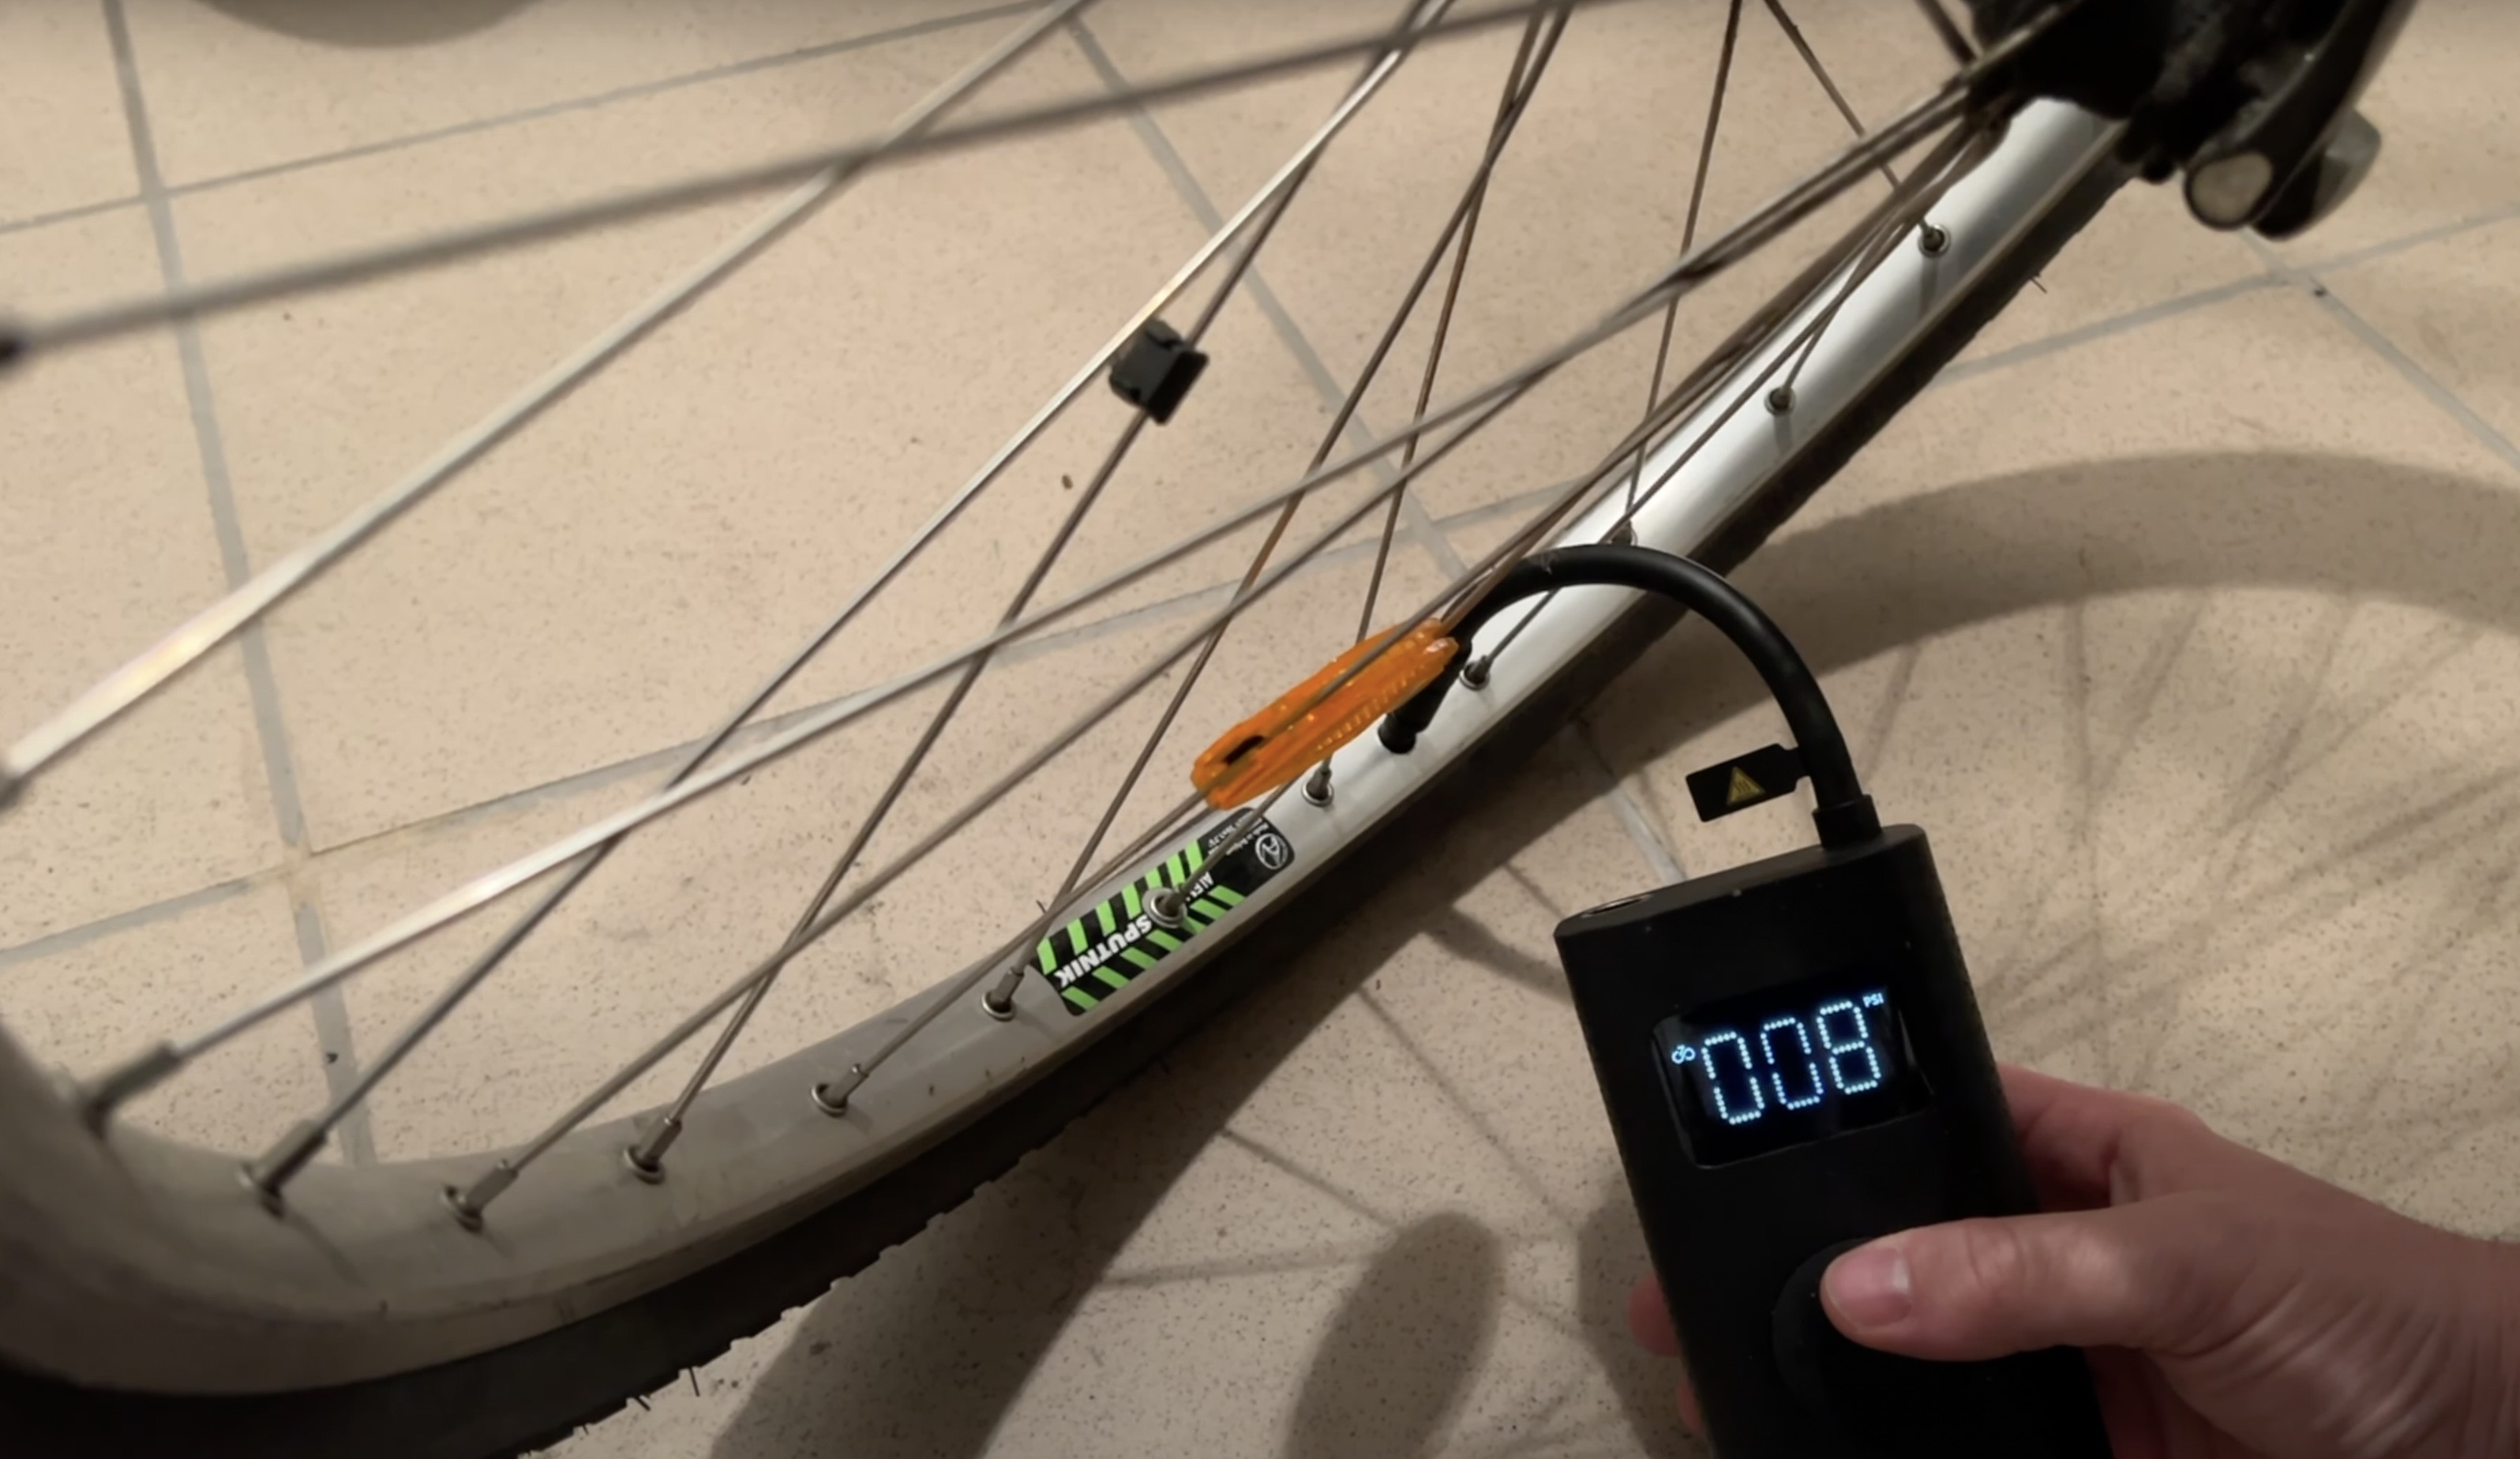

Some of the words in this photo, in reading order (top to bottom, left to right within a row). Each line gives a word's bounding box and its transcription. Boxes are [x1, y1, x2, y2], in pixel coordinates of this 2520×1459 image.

[1055, 916, 1152, 987] SPUTNIK
[1702, 1001, 1881, 1124] 008
[1862, 993, 1884, 1007] PSI
